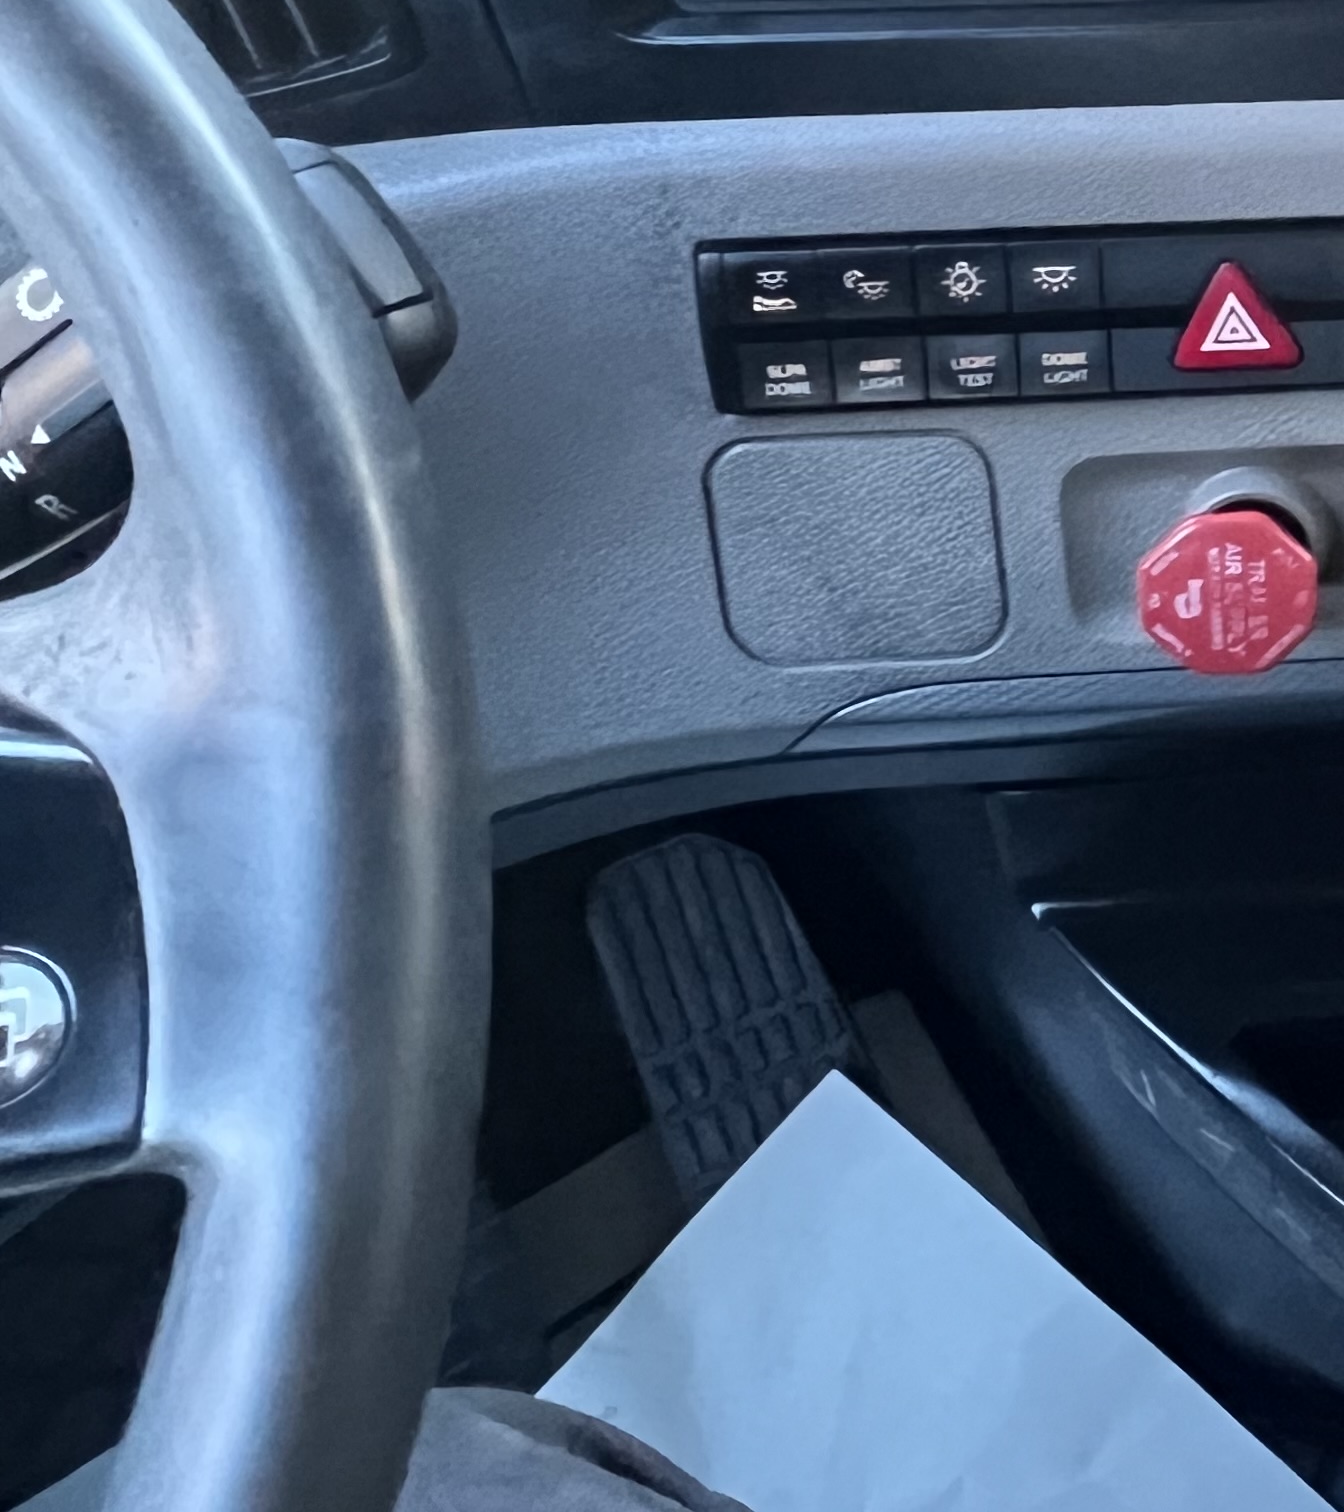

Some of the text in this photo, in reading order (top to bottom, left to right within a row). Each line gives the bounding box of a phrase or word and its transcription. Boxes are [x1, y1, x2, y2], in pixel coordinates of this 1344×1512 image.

[0, 449, 27, 482] N
[34, 493, 78, 521] R
[1225, 543, 1243, 576] AIR
